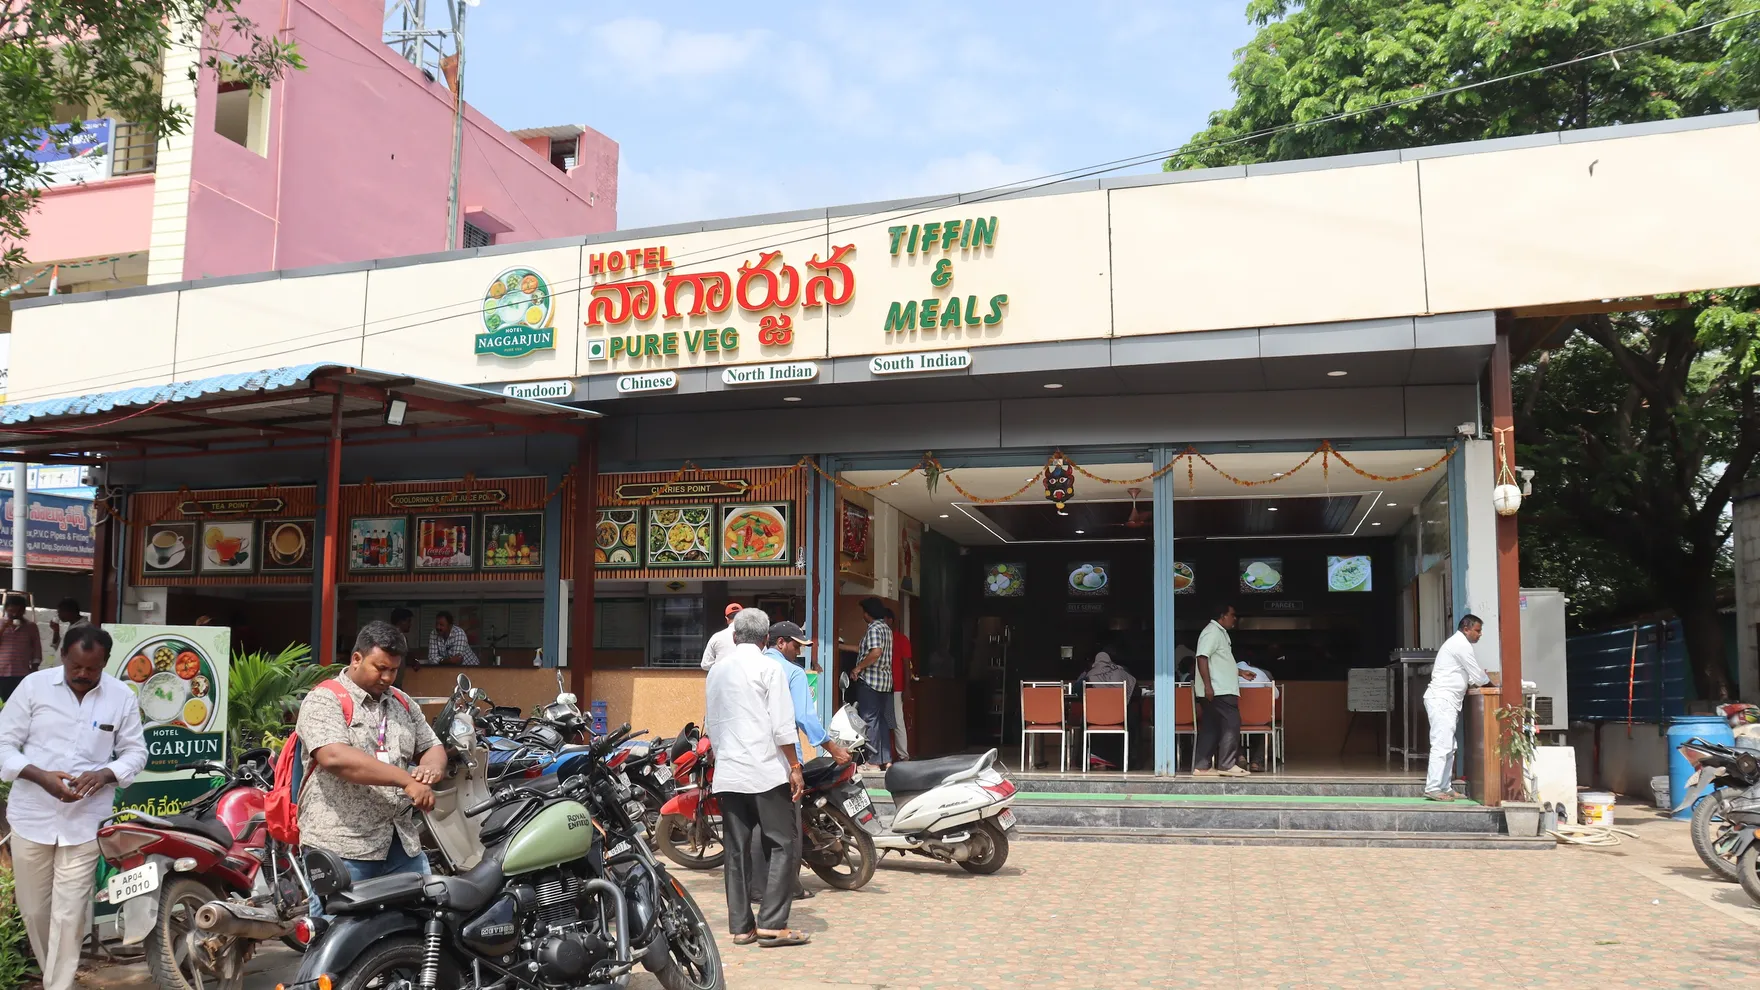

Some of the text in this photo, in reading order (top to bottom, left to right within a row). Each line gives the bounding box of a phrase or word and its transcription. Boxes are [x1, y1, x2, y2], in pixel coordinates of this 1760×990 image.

[887, 215, 999, 256] TIFFIN
[588, 246, 674, 276] HOTEL
[930, 258, 953, 288] &
[583, 243, 857, 346] నాగార్జున
[883, 294, 1009, 332] MEALS
[478, 332, 551, 349] NAGGARJUN
[609, 326, 740, 361] PURE VEG
[873, 353, 967, 371] South Indian
[726, 365, 812, 382] North Indian
[508, 382, 567, 398] Tandoori
[620, 375, 673, 390] Chinese
[651, 484, 711, 494] CURRIES POINT
[441, 495, 458, 503] FUIT
[459, 494, 477, 502] JUCE
[1271, 601, 1296, 609] PARCEL
[153, 729, 179, 737] HOTEL
[148, 738, 219, 758] GARJUN
[567, 812, 587, 823] ROYAL
[568, 819, 590, 831] ENFIELD
[121, 871, 143, 885] AP04
[116, 880, 150, 899] P 0010
